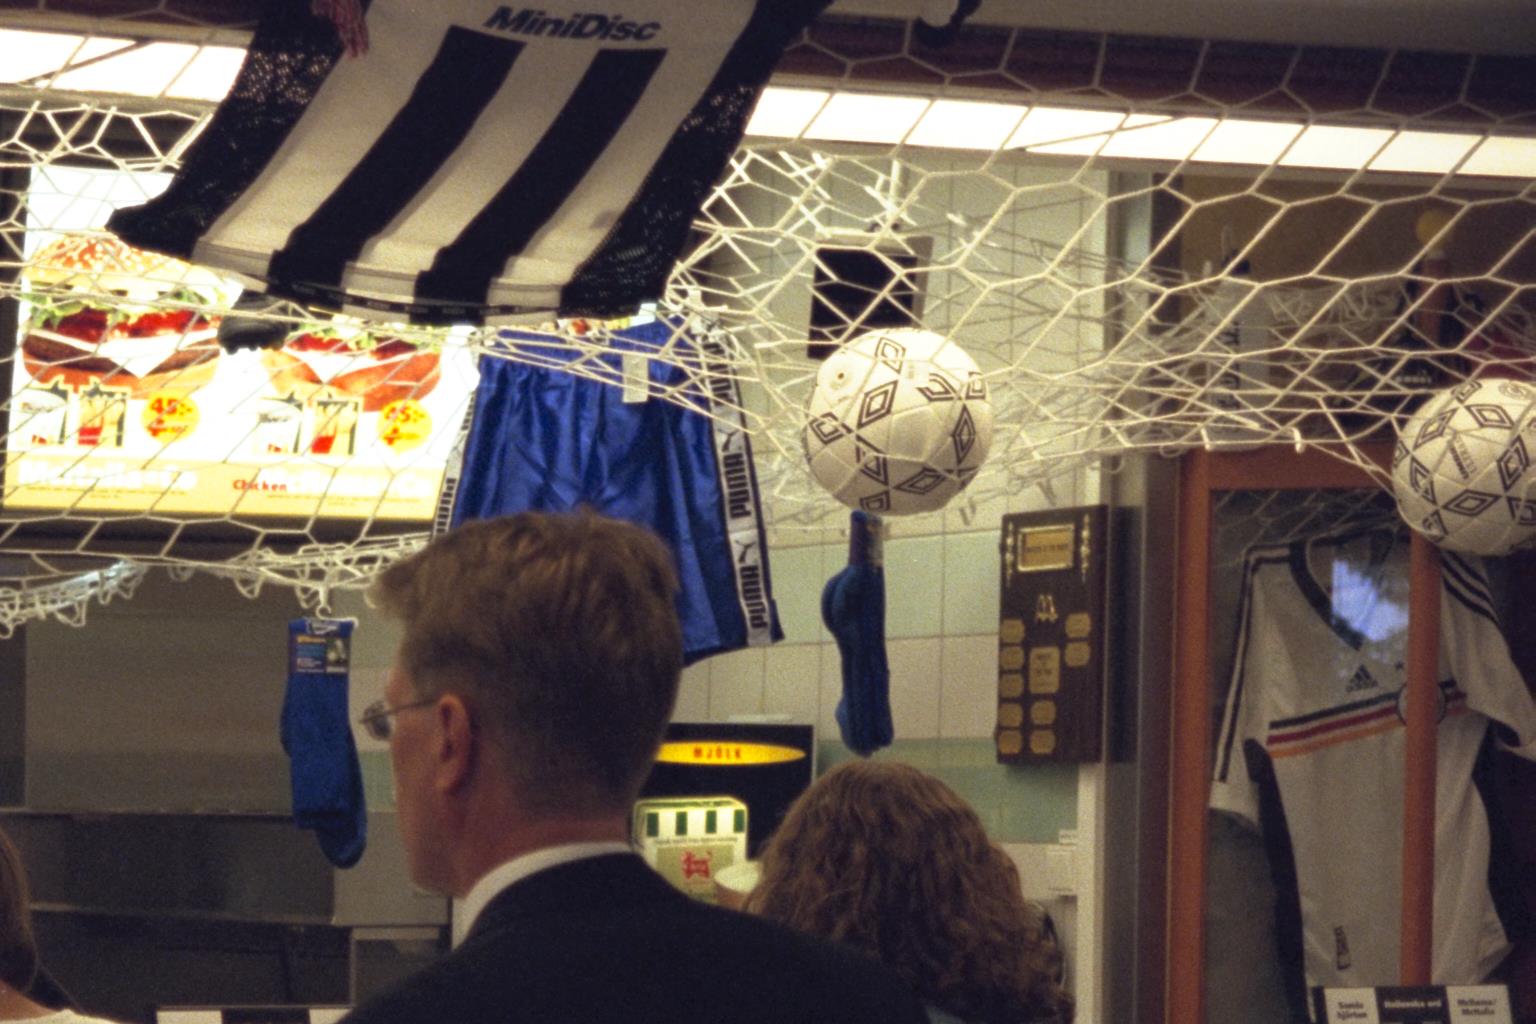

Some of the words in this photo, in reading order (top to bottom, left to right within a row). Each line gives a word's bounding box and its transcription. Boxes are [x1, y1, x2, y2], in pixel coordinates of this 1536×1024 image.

[483, 5, 662, 41] MiniDisc
[725, 452, 752, 520] PUMA
[739, 565, 768, 630] PUMA
